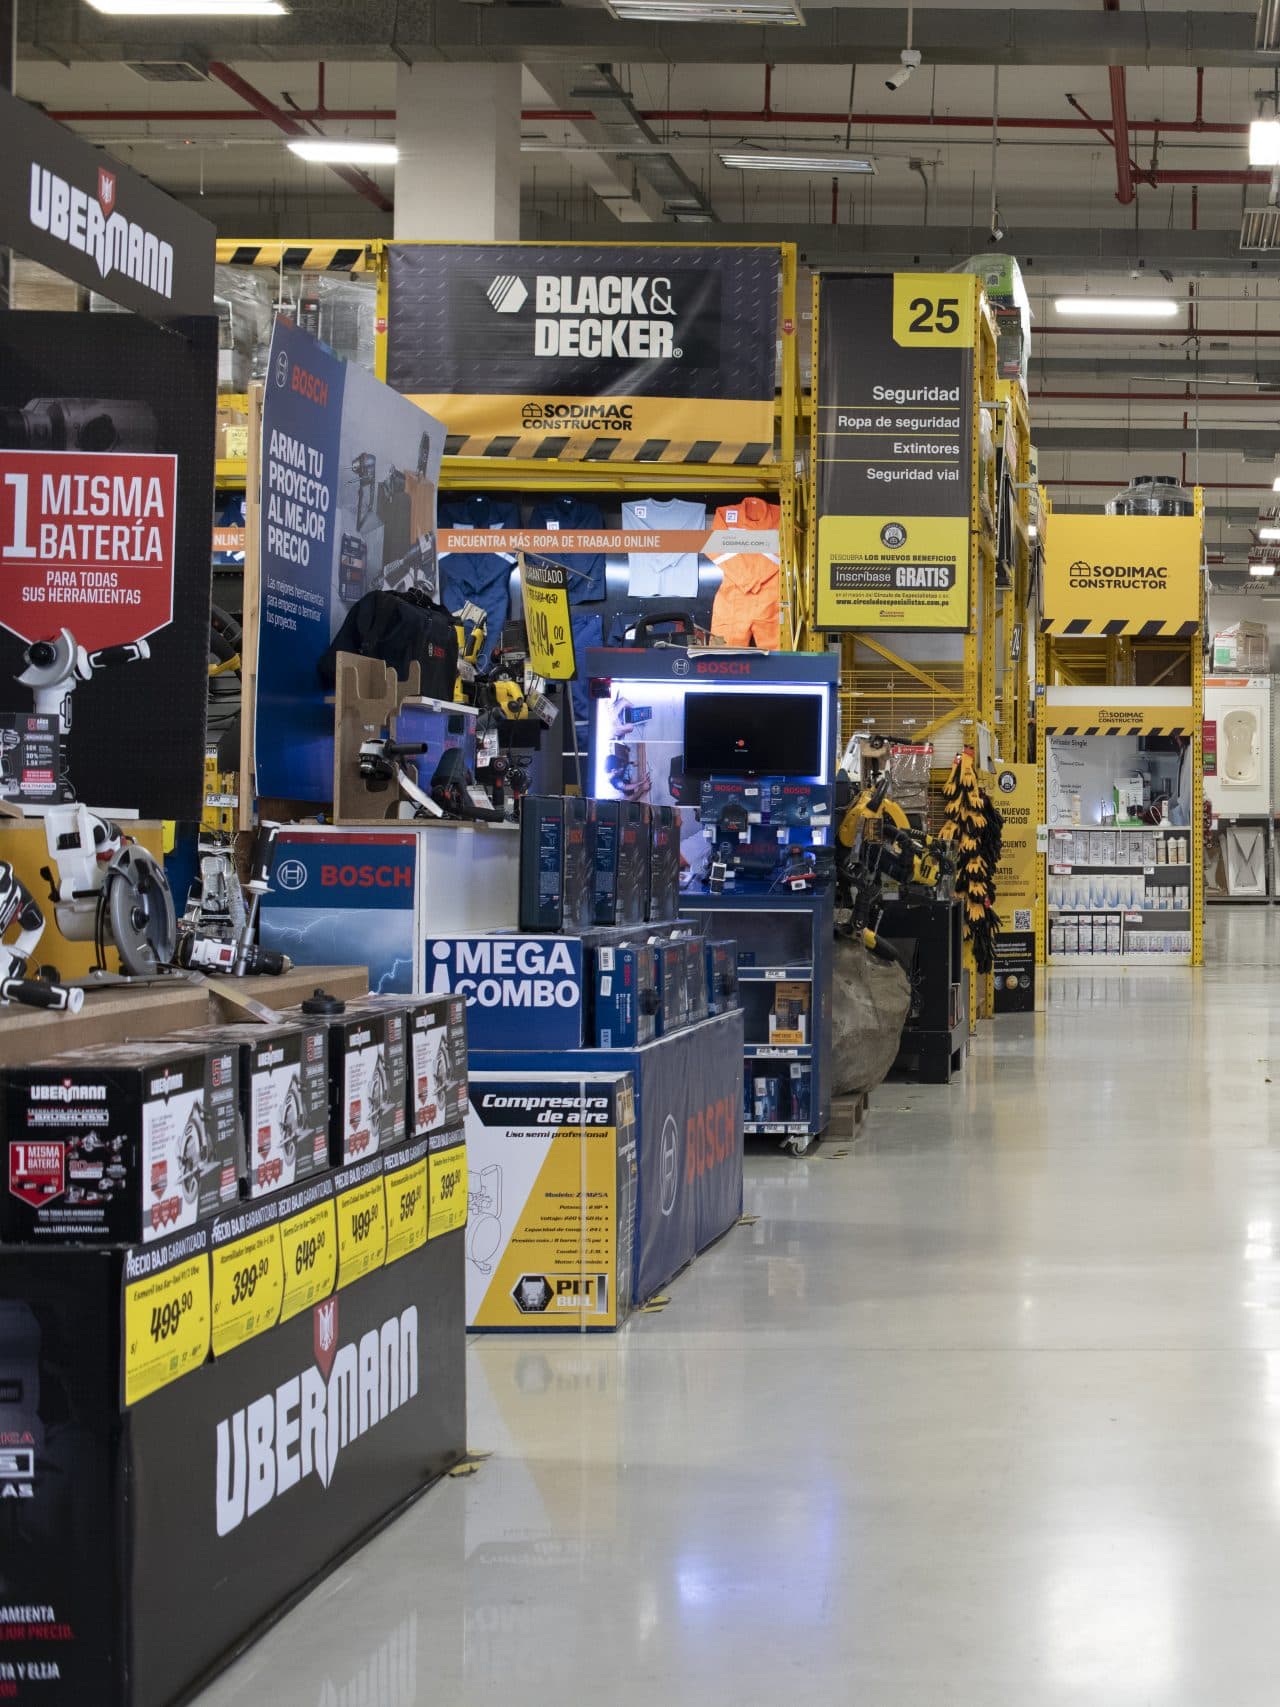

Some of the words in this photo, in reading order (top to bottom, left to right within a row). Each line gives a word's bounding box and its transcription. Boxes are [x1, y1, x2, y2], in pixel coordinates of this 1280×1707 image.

[30, 162, 173, 298] UBERMANN
[909, 298, 960, 333] 25
[534, 318, 673, 359] DECKER
[291, 365, 329, 408] BOSCH
[872, 386, 960, 406] Seguridad
[544, 403, 633, 419] SODIMAC
[522, 419, 633, 431] CONSTRUCTOR
[838, 416, 872, 431] Ropa
[875, 416, 892, 428] de
[895, 417, 960, 432] seguridad
[269, 429, 305, 472] ARMA
[307, 448, 325, 478] TU
[893, 442, 960, 456] Extintores
[867, 468, 933, 483] Seguridad
[936, 469, 960, 481] vial
[269, 464, 330, 513] PROYECTO
[3, 473, 36, 559] 1
[42, 475, 164, 518] MISMA
[268, 502, 287, 530] AL
[286, 506, 326, 543] MEJOR
[40, 521, 163, 562] BATERÍA
[214, 534, 245, 545] NLINE
[268, 529, 310, 567] PRECIO
[448, 535, 506, 547] ENCUENTRA
[510, 533, 530, 547] MÁS
[533, 535, 559, 547] ROPA
[561, 536, 575, 547] DE
[577, 536, 621, 547] TRABAJO
[624, 536, 660, 548] ONLINE
[46, 571, 78, 588] PARA
[80, 571, 118, 588] TODAS
[836, 571, 891, 582] Inscríbase
[896, 567, 949, 588] GRATIS
[1093, 565, 1167, 578] SODIMAC
[267, 575, 278, 590] Las
[1069, 579, 1167, 590] CONSTRUCTOR
[22, 587, 46, 602] SUS
[48, 588, 141, 605] HERRAMIENTAS
[697, 662, 750, 674] BOSCH
[714, 784, 742, 792] BOSCH
[783, 786, 811, 794] BOSCH
[321, 865, 412, 887] BOSCH
[455, 979, 580, 1008] COMBO
[31, 1085, 107, 1102] UBERMANN
[482, 1094, 608, 1111] Compresora
[537, 1110, 564, 1123] de
[551, 1131, 608, 1139] profeonal
[687, 1096, 735, 1185] BOSCH
[16, 1146, 27, 1175] 1
[28, 1146, 60, 1158] MISMA
[28, 1158, 60, 1169] BATERÍA
[292, 1195, 303, 1212] BAJO
[231, 1215, 245, 1236] BAJO
[245, 1203, 277, 1230] GARANTIZADO
[34, 1226, 109, 1234] www.UBERMANN.com
[127, 1250, 150, 1279] PRECIO
[151, 1249, 167, 1269] BAJO
[168, 1231, 206, 1262] GARANTIZADO
[557, 1280, 594, 1295] PIT
[216, 1305, 418, 1537] UBERMANN
[16, 1662, 26, 1680] Y
[27, 1661, 60, 1680] ELIJA
